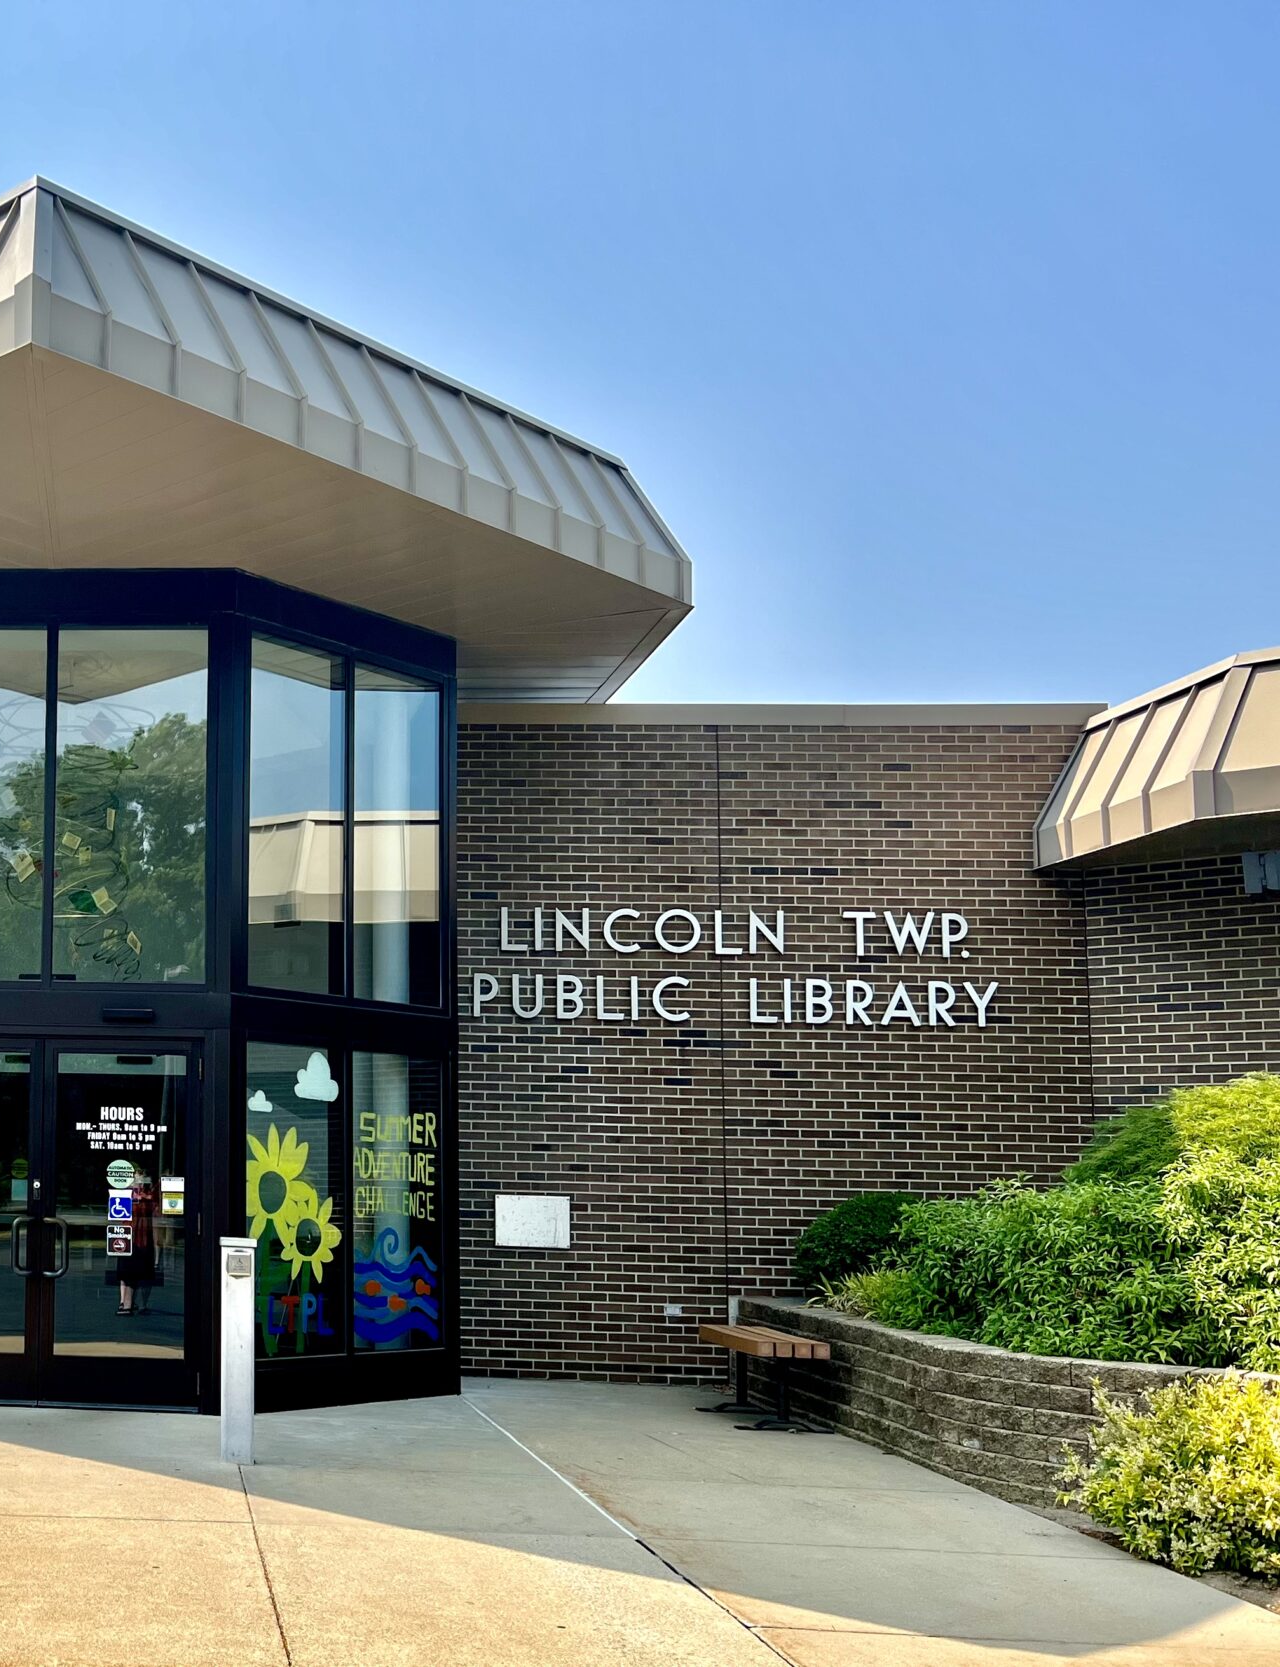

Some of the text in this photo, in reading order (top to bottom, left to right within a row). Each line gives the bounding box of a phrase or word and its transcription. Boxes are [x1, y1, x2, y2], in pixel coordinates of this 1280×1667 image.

[500, 906, 969, 960] LINCOLN TWP.
[473, 972, 1000, 1028] PUBLIC LIBRARY
[99, 1122, 122, 1132] THURS.
[141, 1123, 148, 1132] to
[157, 1125, 168, 1133] pm
[100, 1106, 144, 1121] HOURS
[360, 1112, 437, 1148] SUMMER
[87, 1131, 111, 1140] FRIDAY
[129, 1132, 136, 1141] to
[138, 1132, 143, 1141] 5
[145, 1134, 156, 1143] pm
[90, 1141, 153, 1152] SAT. 10am to 5 pm
[353, 1146, 436, 1186] ADVENTURE
[268, 1292, 335, 1336] LTPL
